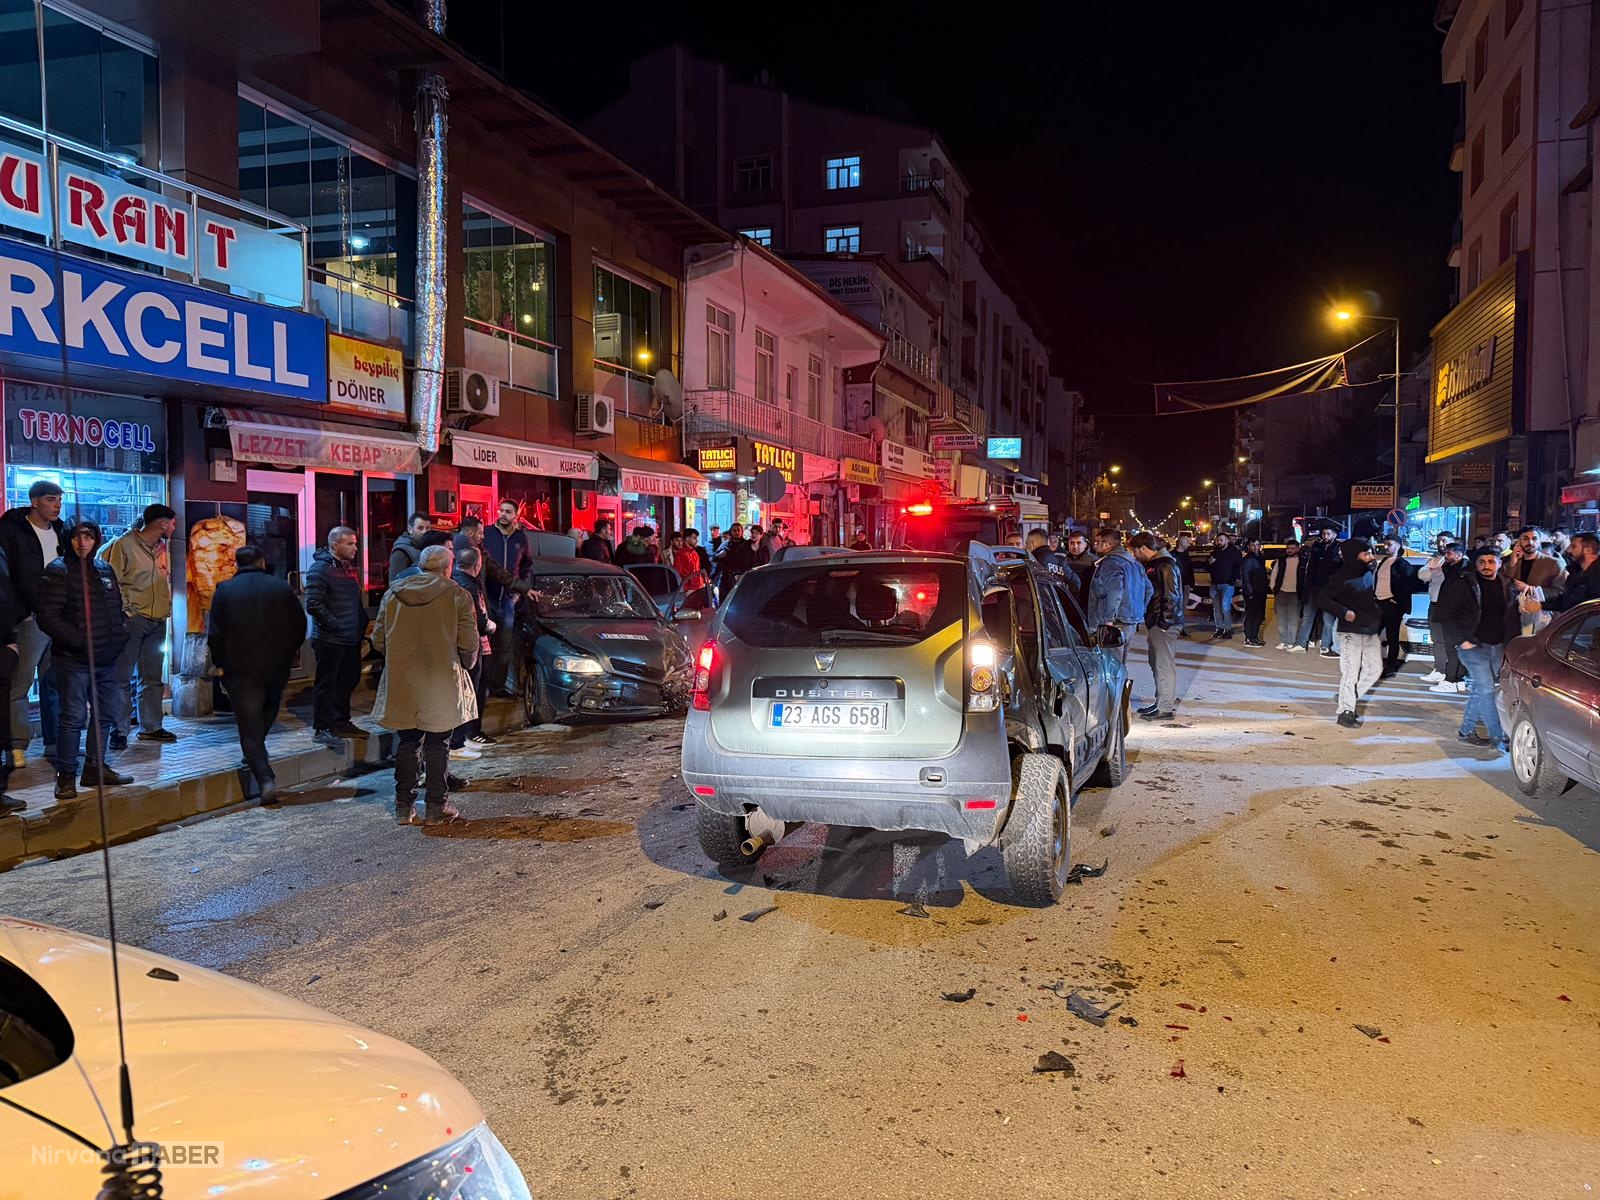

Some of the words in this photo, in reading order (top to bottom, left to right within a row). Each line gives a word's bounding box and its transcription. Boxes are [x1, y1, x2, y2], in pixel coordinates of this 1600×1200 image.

[338, 379, 385, 404] DÖNER
[19, 408, 155, 452] TEKNOCELL
[238, 433, 306, 458] LEZZET
[330, 443, 382, 464] KEBAP
[473, 446, 497, 463] LİDER
[701, 450, 732, 460] TATLICI
[754, 442, 795, 470] TATLICI
[720, 460, 734, 468] USTA
[632, 476, 660, 493] BULUT
[784, 706, 802, 723] 23
[811, 706, 841, 724] AGS
[849, 707, 880, 726] 658
